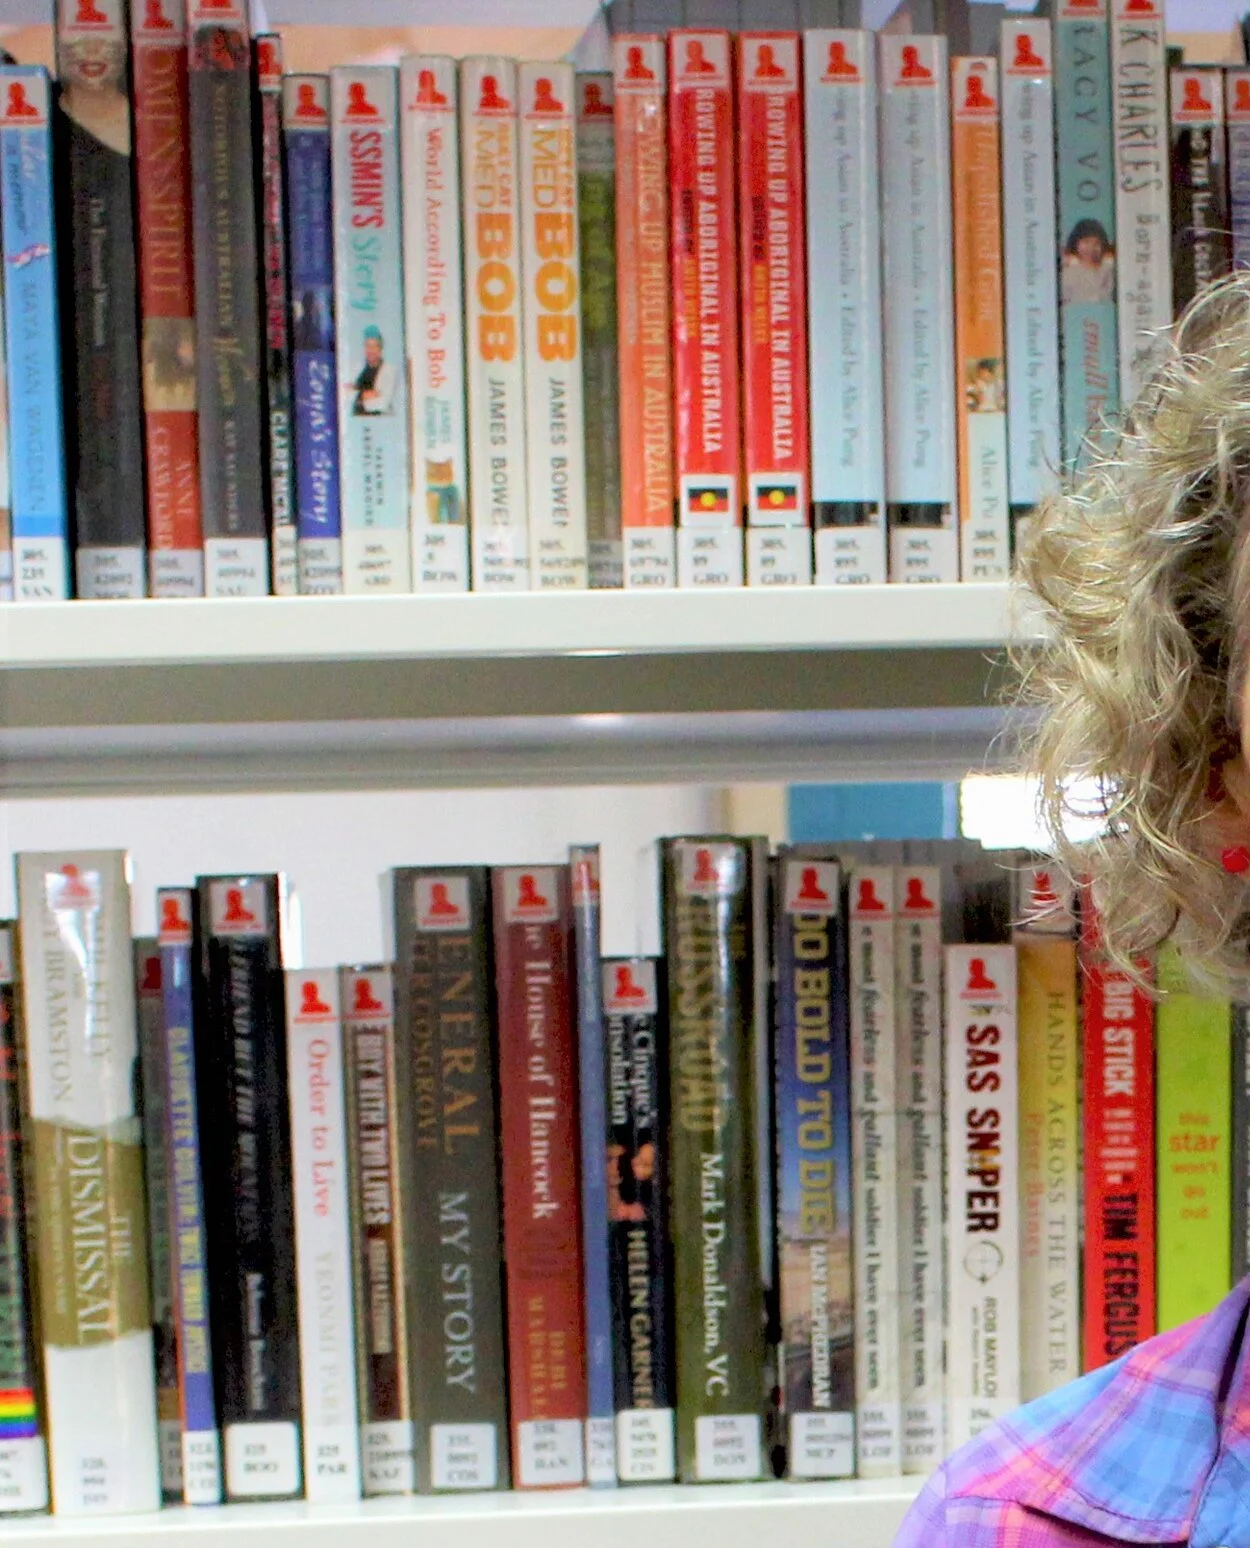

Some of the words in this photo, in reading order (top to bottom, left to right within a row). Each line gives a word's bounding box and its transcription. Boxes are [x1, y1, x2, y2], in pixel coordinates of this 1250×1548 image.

[423, 127, 444, 189] World
[1117, 61, 1162, 194] CHARLES
[697, 172, 717, 196] UP
[769, 179, 788, 203] UP
[1076, 151, 1101, 204] VO
[422, 196, 446, 307] According
[640, 221, 664, 255] UP
[698, 200, 720, 322] ABORIGINAL
[769, 208, 791, 327] ABORIGINAL
[350, 236, 380, 313] Story
[476, 212, 516, 363] BOB
[535, 212, 578, 363] BOB
[640, 261, 665, 346] MUSLIM
[427, 312, 446, 342] To
[700, 327, 720, 345] IN
[772, 332, 790, 352] IN
[304, 360, 332, 441] Zoya's
[428, 348, 448, 389] Bob
[642, 355, 667, 379] IN
[488, 377, 508, 446] JAMES
[547, 377, 567, 446] JAMES
[700, 351, 722, 453] AUSTRALIA
[772, 358, 793, 459] AUSTRALIA
[642, 386, 669, 514] AUSTRALIA
[980, 445, 998, 493] Alice
[304, 448, 334, 523] Story
[525, 960, 555, 1047] House
[793, 969, 831, 1082] BOLD
[856, 988, 882, 1066] fearless
[1103, 981, 1134, 1023] BIG
[527, 1054, 554, 1085] of
[965, 1023, 1001, 1093] SAS
[1046, 990, 1068, 1086] HANDS
[1103, 1026, 1134, 1098] STICK
[307, 1039, 334, 1116] Order
[642, 1031, 667, 1130] Cinque's
[863, 1070, 881, 1103] and
[910, 1070, 929, 1103] and
[311, 1125, 331, 1151] to
[796, 1089, 832, 1150] TO
[857, 1107, 884, 1182] gallant
[903, 1107, 930, 1182] gallant
[1046, 1097, 1068, 1204] ACROSS
[1168, 1131, 1220, 1154] star
[313, 1159, 336, 1218] Live
[529, 1094, 561, 1221] Hancock
[700, 1151, 723, 1216] Mark
[437, 1190, 468, 1258] MY
[799, 1159, 837, 1231] DIE
[863, 1186, 882, 1247] soldier
[1103, 1192, 1140, 1240] TIM
[67, 1135, 112, 1345] DISMISSAL
[636, 1228, 659, 1309] HELEN
[1048, 1217, 1069, 1274] THE
[863, 1262, 882, 1304] have
[911, 1262, 928, 1304] have
[984, 1296, 998, 1333] ROB
[441, 1262, 476, 1394] STORY
[864, 1308, 879, 1345] ever
[1049, 1281, 1070, 1374] WATER
[705, 1358, 728, 1397] VC
